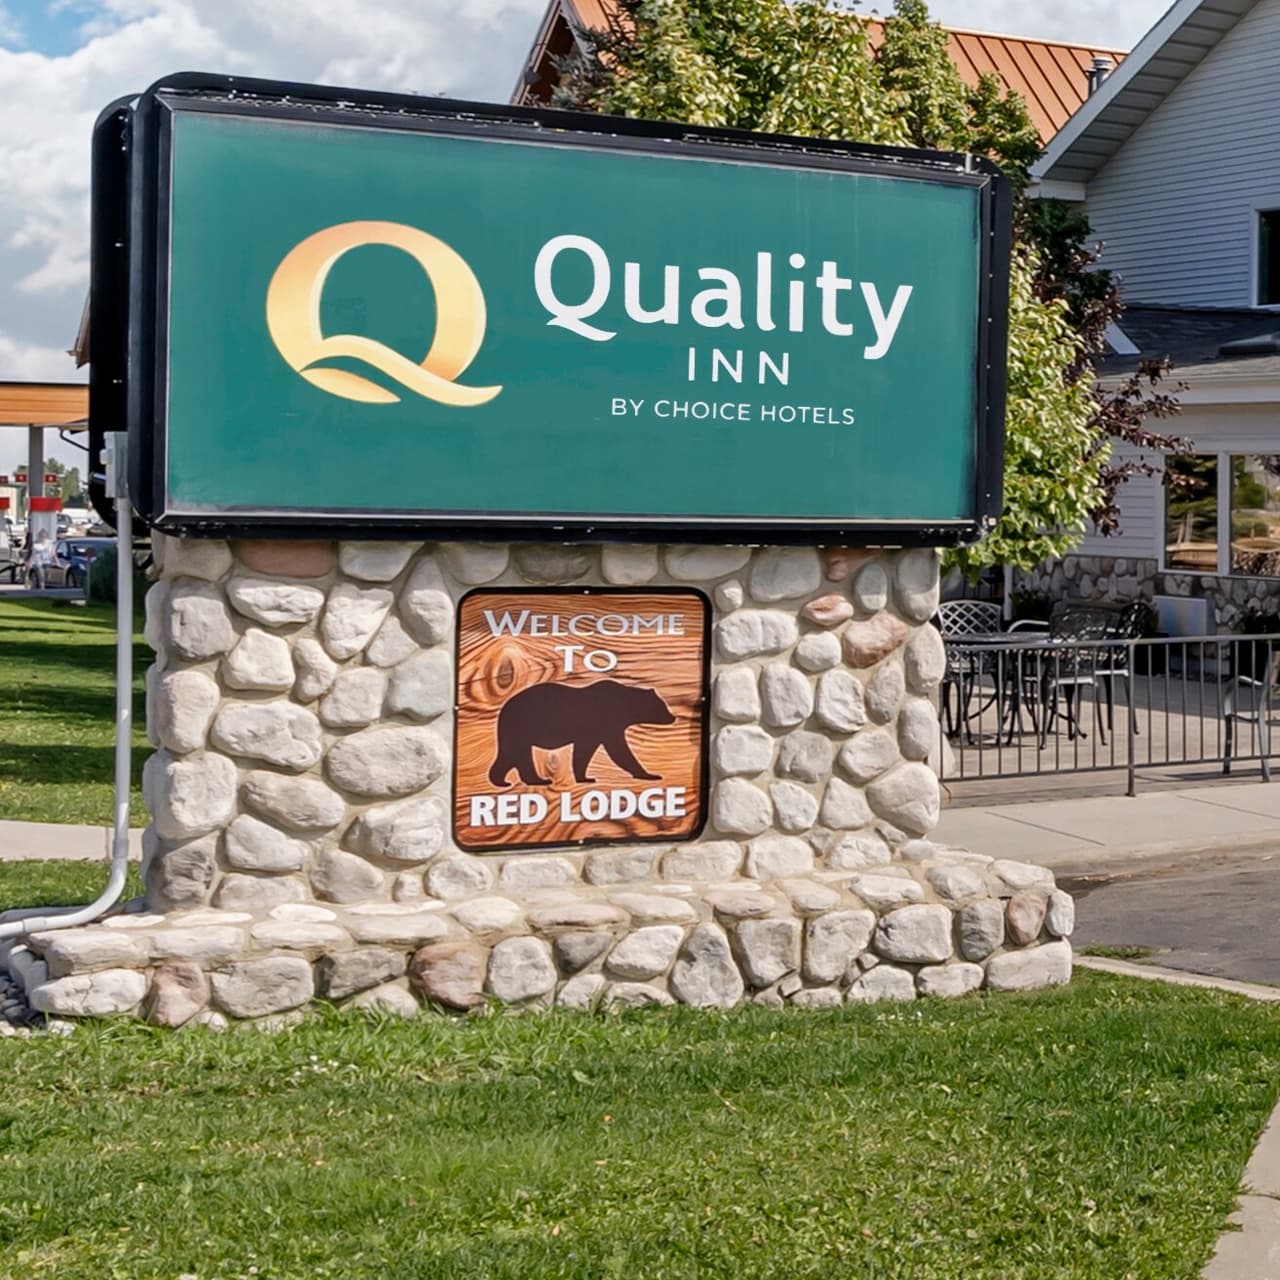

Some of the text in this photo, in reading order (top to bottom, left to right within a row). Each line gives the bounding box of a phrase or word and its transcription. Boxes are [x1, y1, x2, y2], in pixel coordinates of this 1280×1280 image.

[533, 234, 914, 361] Quality
[686, 346, 790, 386] INN
[611, 397, 856, 426] BY CHOICE HOTELS
[483, 609, 686, 637] WELCOME
[469, 786, 687, 827] RED LODGE
